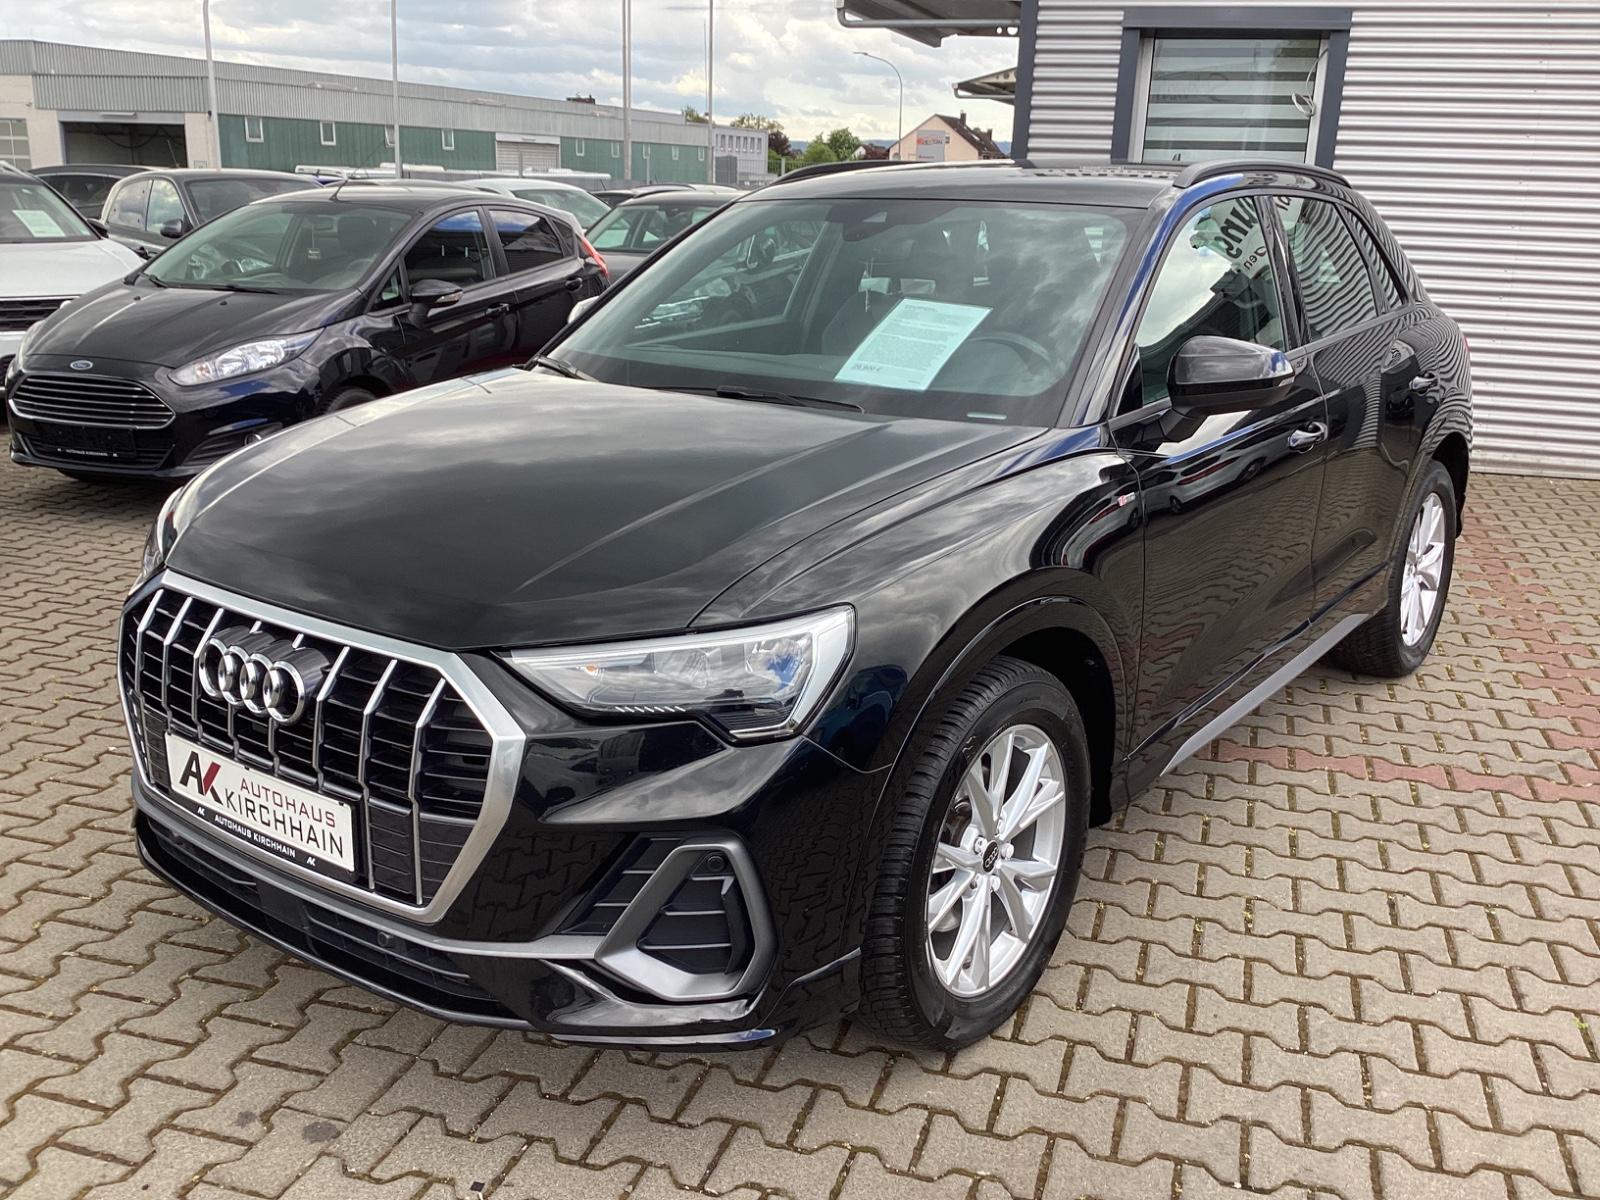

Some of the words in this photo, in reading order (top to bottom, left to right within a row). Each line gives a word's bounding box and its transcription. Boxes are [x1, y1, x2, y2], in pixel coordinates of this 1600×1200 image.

[225, 788, 343, 858] KIRCHHAIN
[240, 777, 336, 828] AUTOHAUS
[214, 814, 252, 838] AUTOHAUS
[253, 833, 296, 858] KIRCHHAIN
